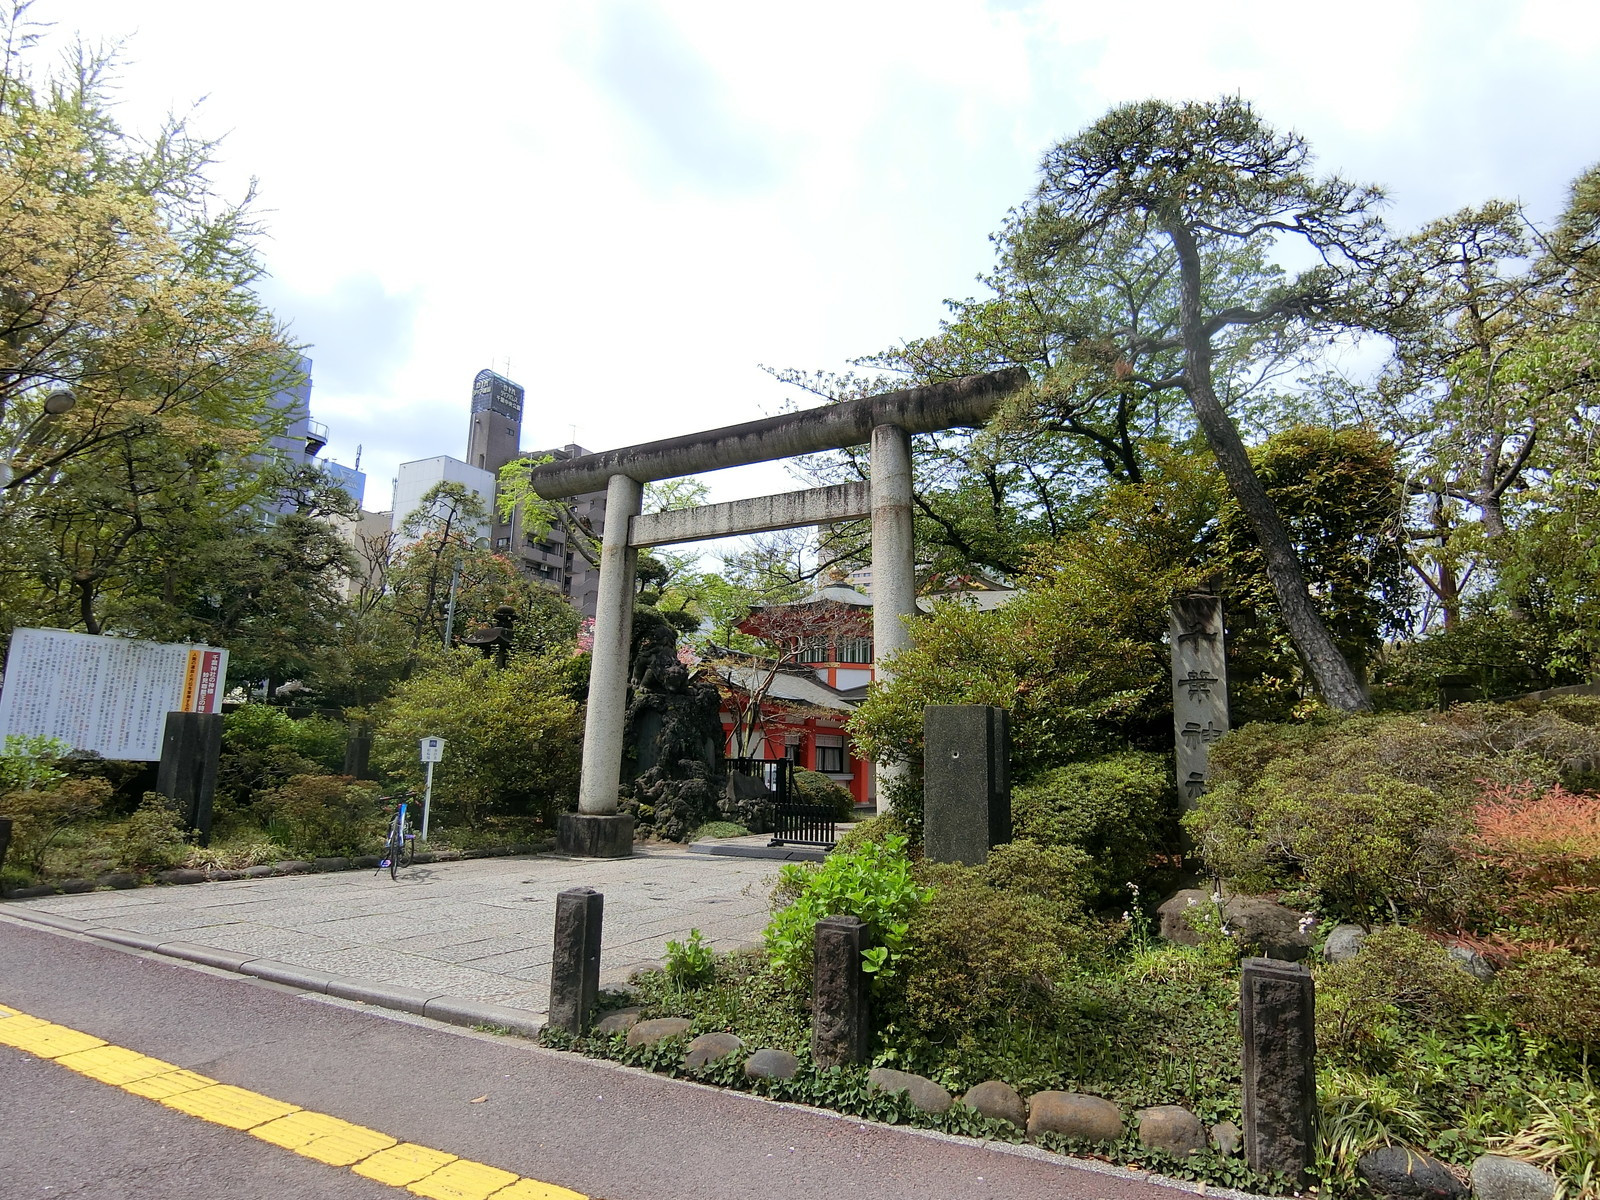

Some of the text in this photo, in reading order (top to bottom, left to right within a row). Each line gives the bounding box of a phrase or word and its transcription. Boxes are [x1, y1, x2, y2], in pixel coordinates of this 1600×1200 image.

[496, 395, 521, 411] 千葉中央公園
[198, 671, 210, 713] 妙見尊星王の特
[207, 654, 219, 695] 千葉神社の神様
